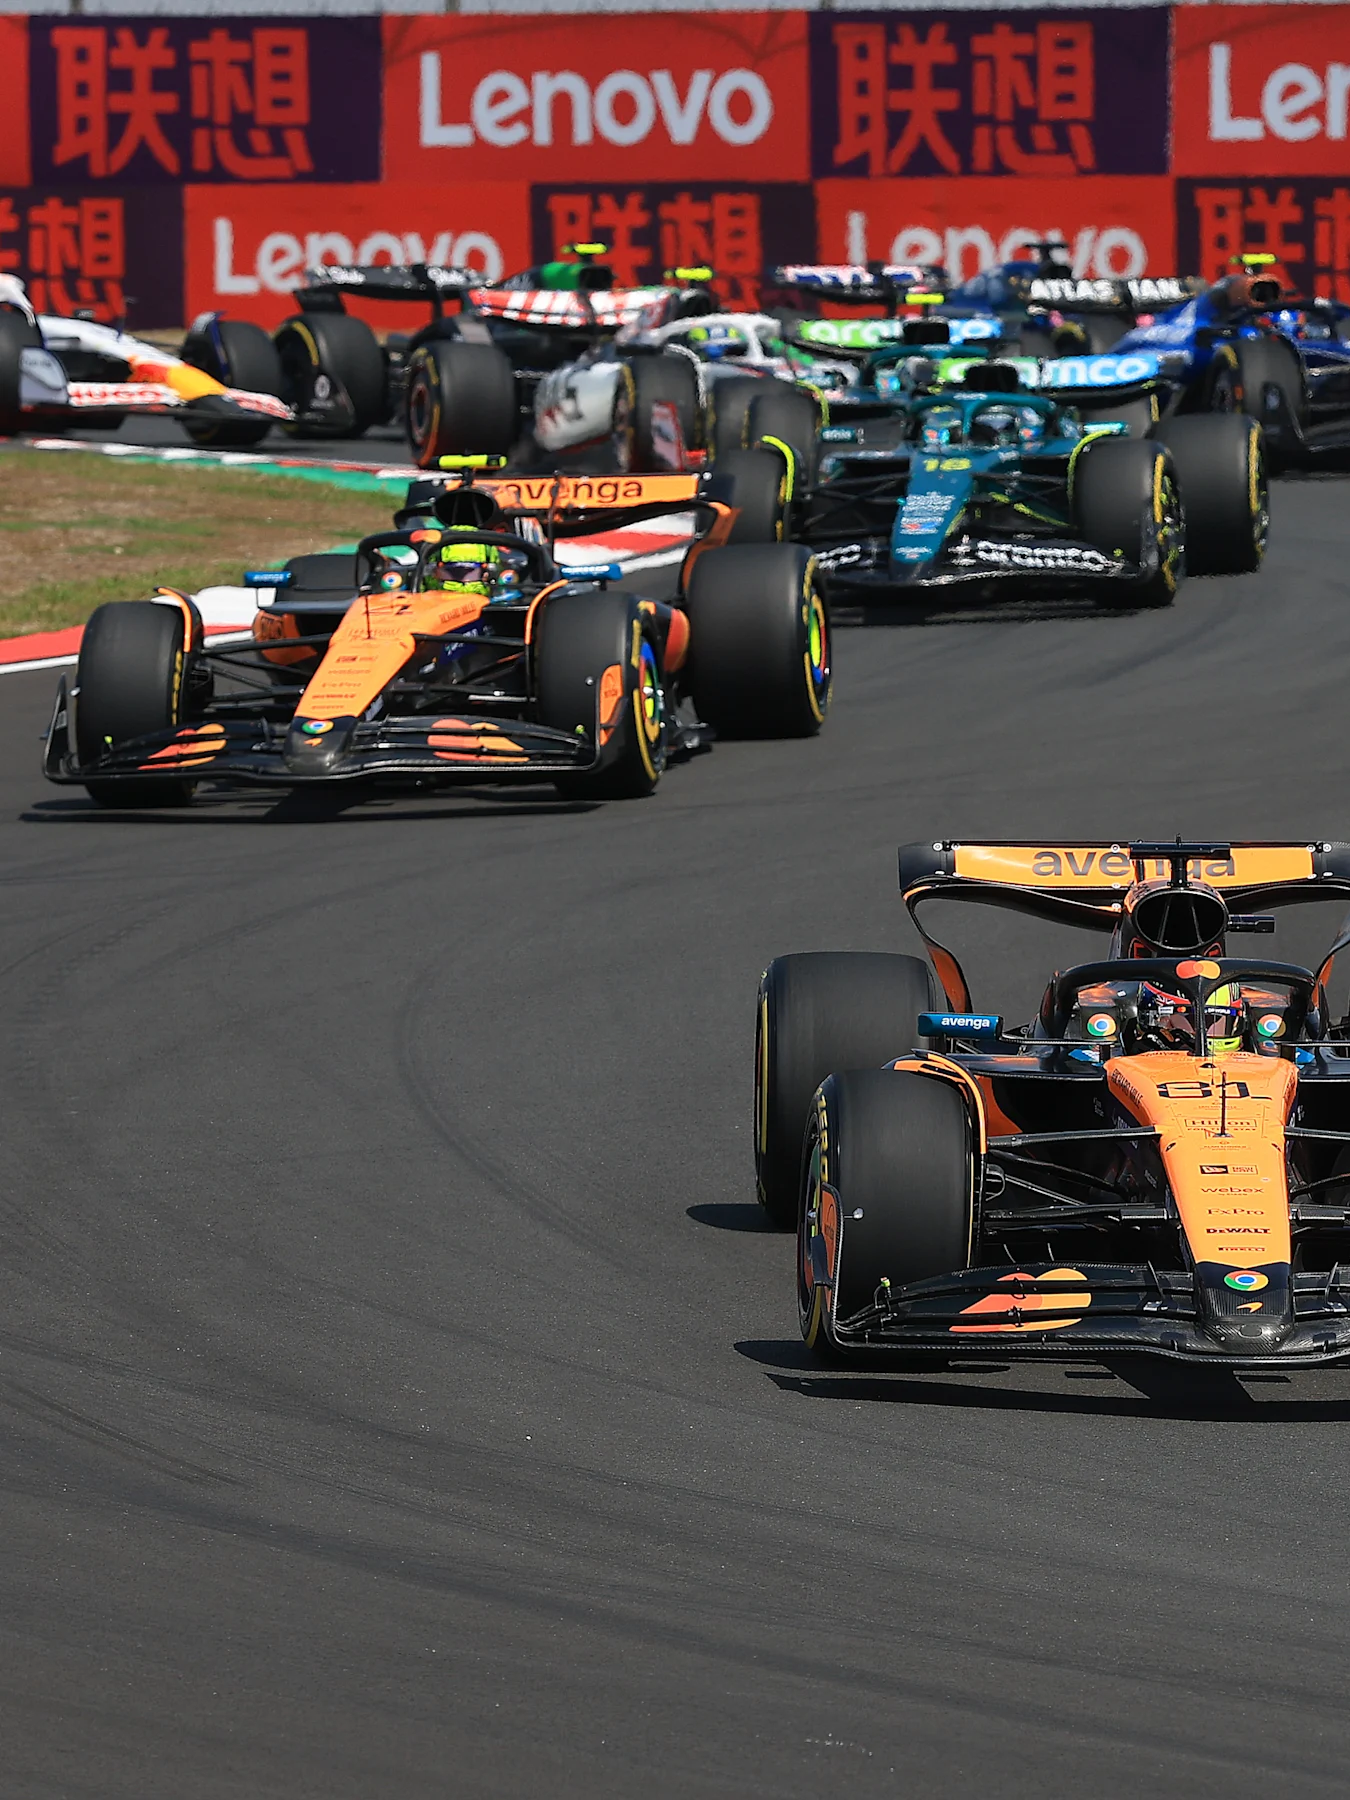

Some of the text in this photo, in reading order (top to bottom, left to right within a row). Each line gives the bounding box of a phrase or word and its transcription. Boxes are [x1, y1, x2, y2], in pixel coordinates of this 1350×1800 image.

[51, 27, 313, 178] 联想
[419, 51, 772, 147] Lenovo
[833, 22, 1095, 176] 联想
[0, 197, 127, 322] 想
[940, 1015, 991, 1029] avenga
[1200, 1186, 1265, 1194] webex
[1207, 1208, 1265, 1216] FxPro
